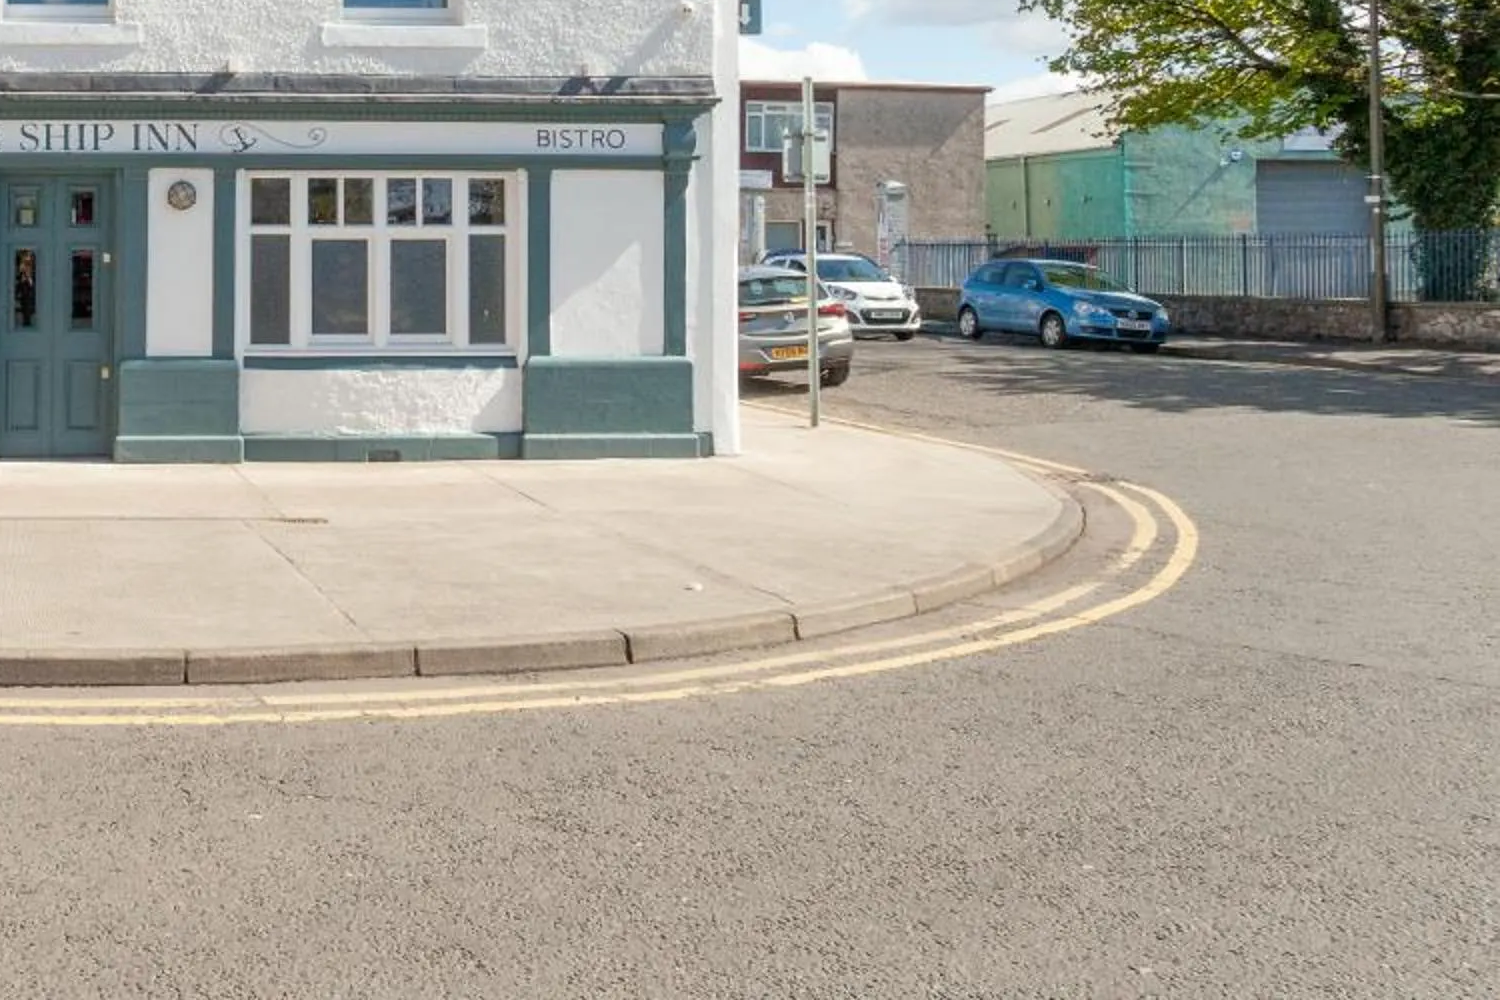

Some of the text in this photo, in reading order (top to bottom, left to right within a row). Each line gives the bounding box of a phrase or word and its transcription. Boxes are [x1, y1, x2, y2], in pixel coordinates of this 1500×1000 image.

[20, 123, 115, 151] SHIP
[132, 123, 199, 151] INN
[536, 129, 626, 149] BISTRO
